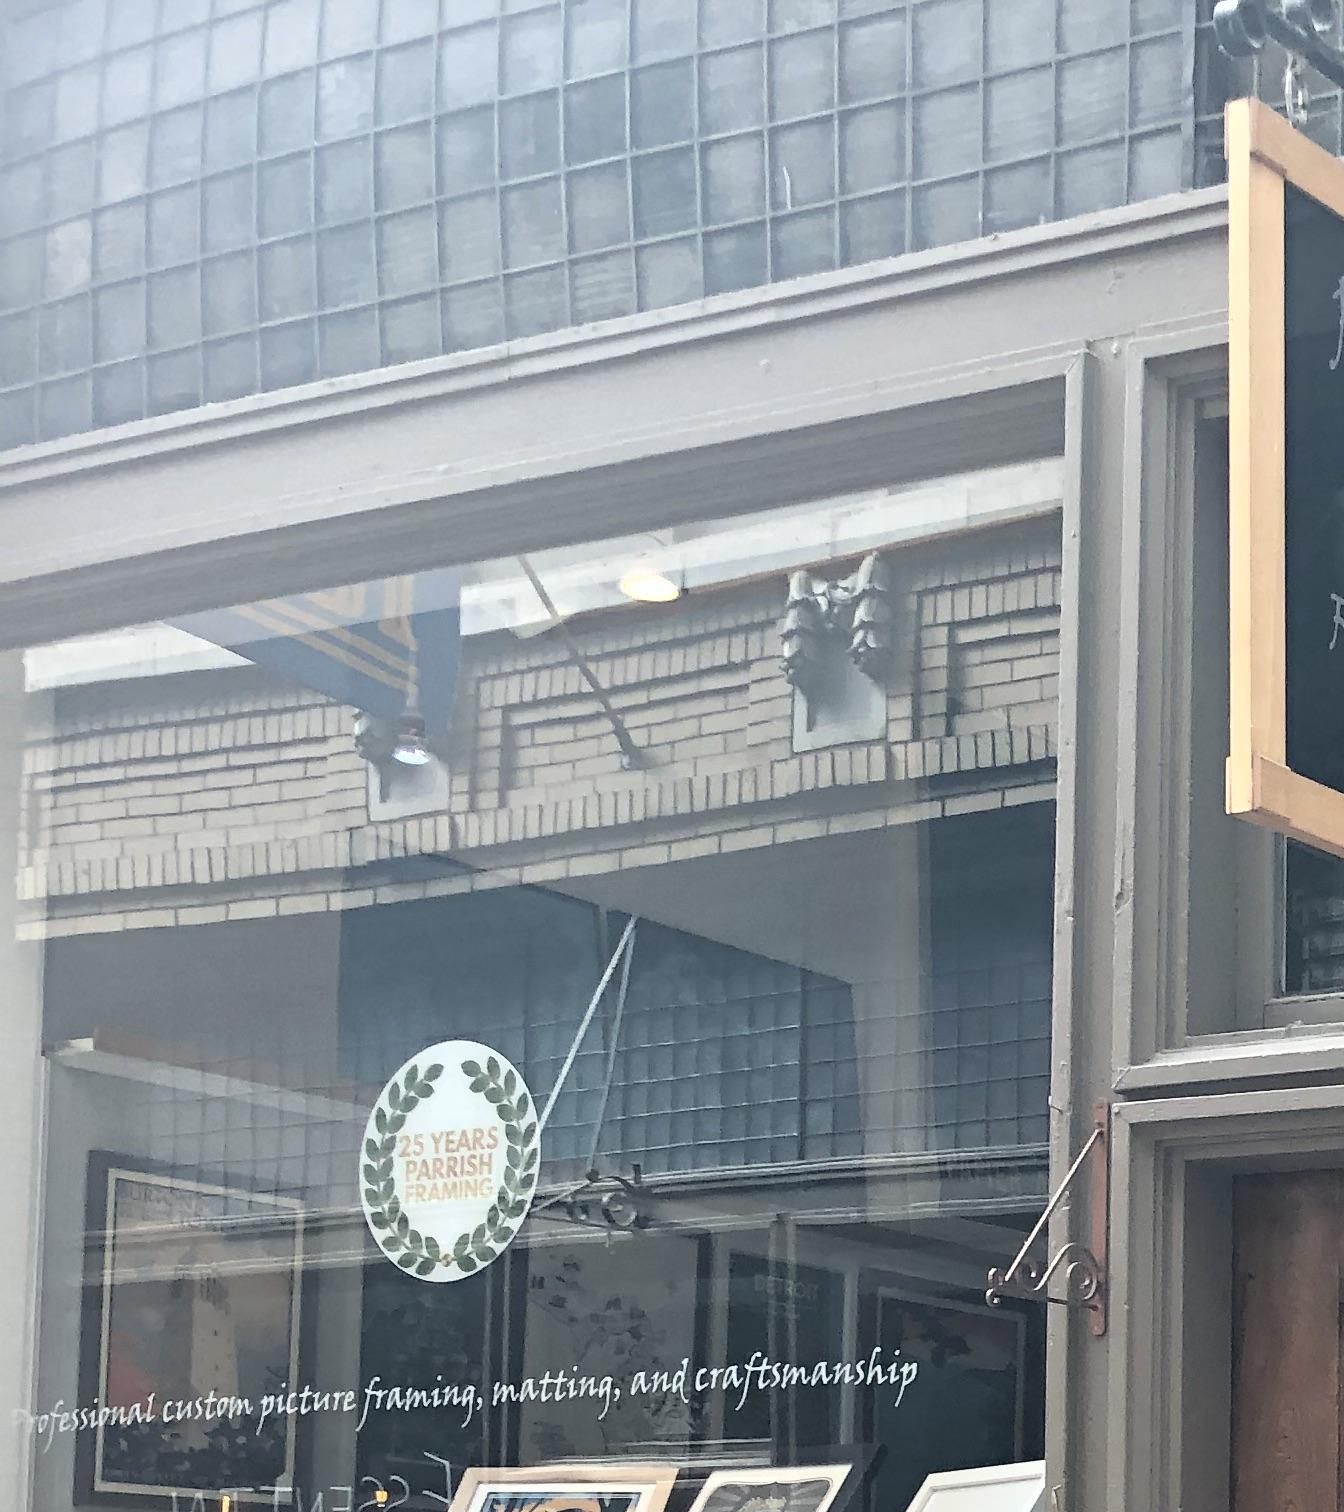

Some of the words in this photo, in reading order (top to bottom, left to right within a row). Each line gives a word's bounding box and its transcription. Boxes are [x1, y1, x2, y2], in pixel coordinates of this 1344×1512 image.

[399, 1134, 424, 1158] 25
[431, 1126, 498, 1155] YEARS
[405, 1153, 493, 1181] PARRISH
[405, 1178, 494, 1203] FRAMING
[163, 1388, 253, 1425] custom
[256, 1382, 357, 1436] picture
[356, 1375, 484, 1433] framing,
[492, 1365, 621, 1421] matting,
[630, 1358, 690, 1404] and
[695, 1346, 920, 1411] craftsmanship
